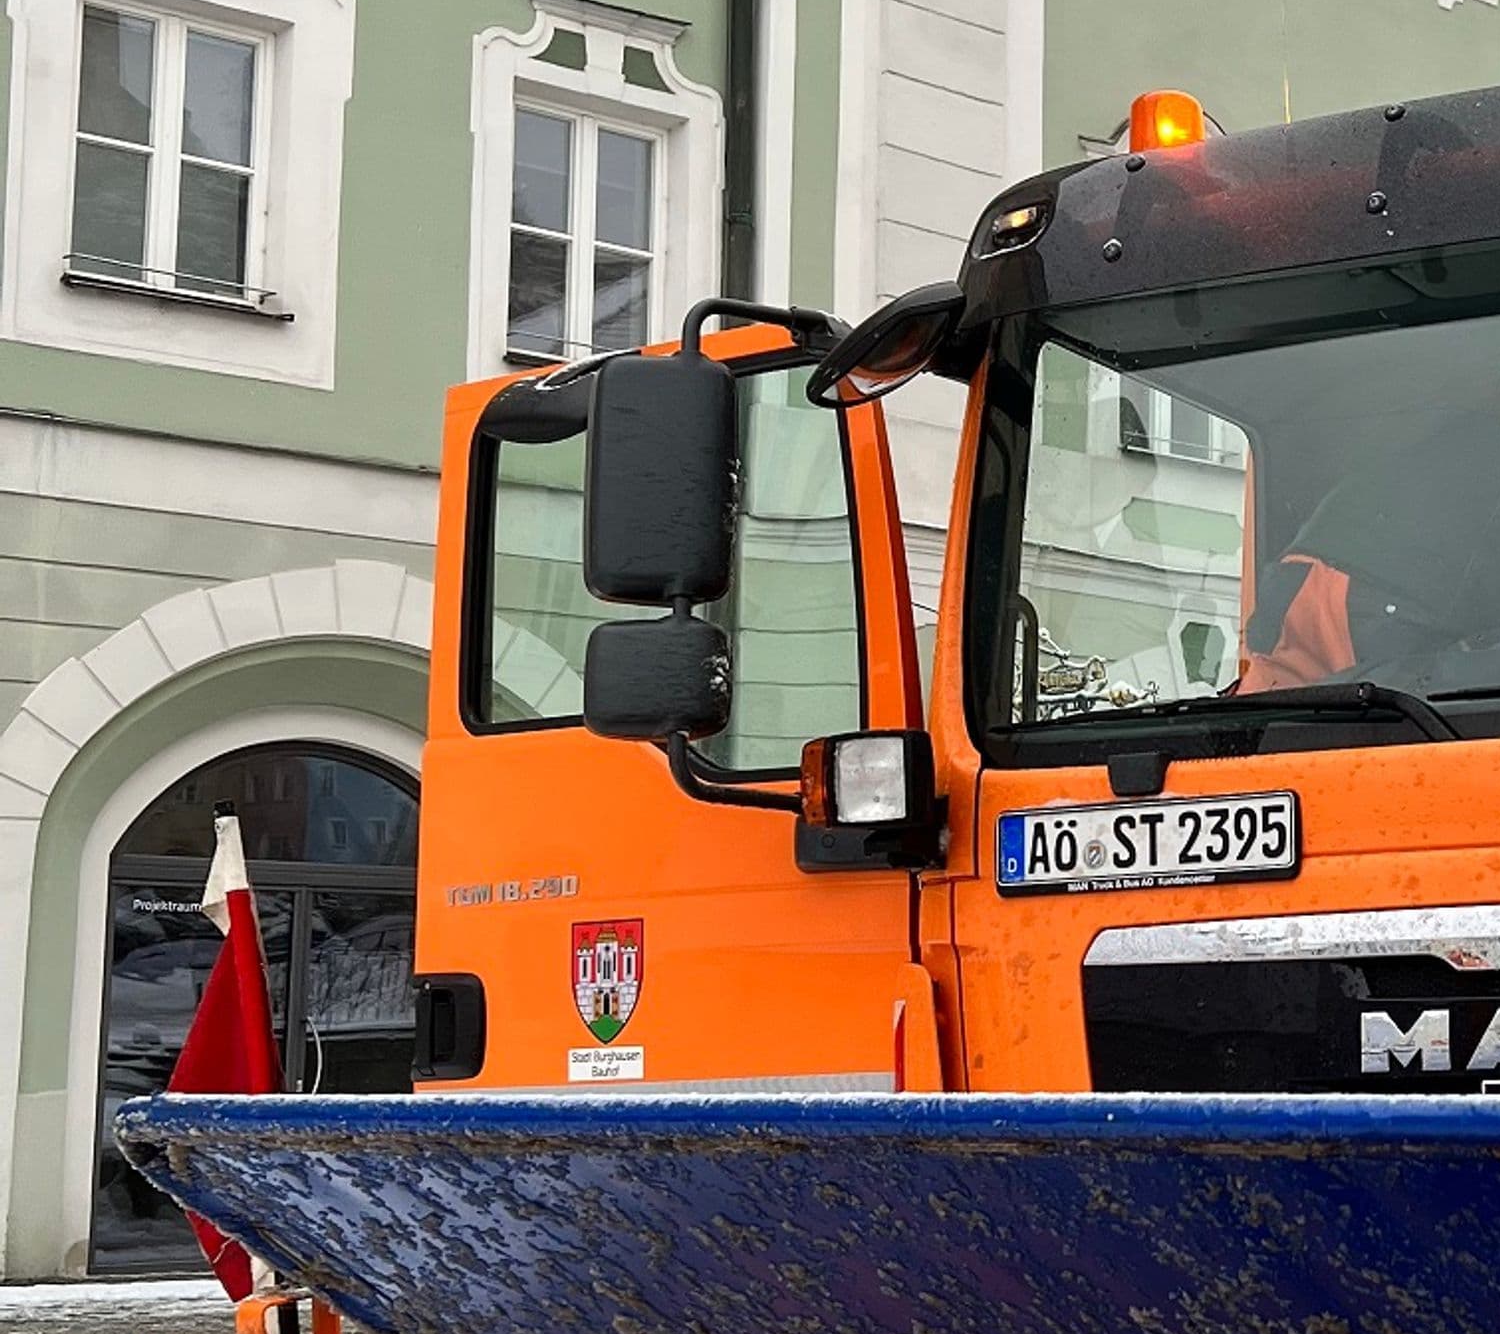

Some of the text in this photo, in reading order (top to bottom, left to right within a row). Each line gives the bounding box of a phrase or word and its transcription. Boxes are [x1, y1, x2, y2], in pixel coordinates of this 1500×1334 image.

[1008, 805, 1287, 874] D AÖ ST 2395
[447, 875, 580, 906] TGM 18.290
[132, 898, 202, 914] Projektraum
[571, 1051, 593, 1064] Stadt
